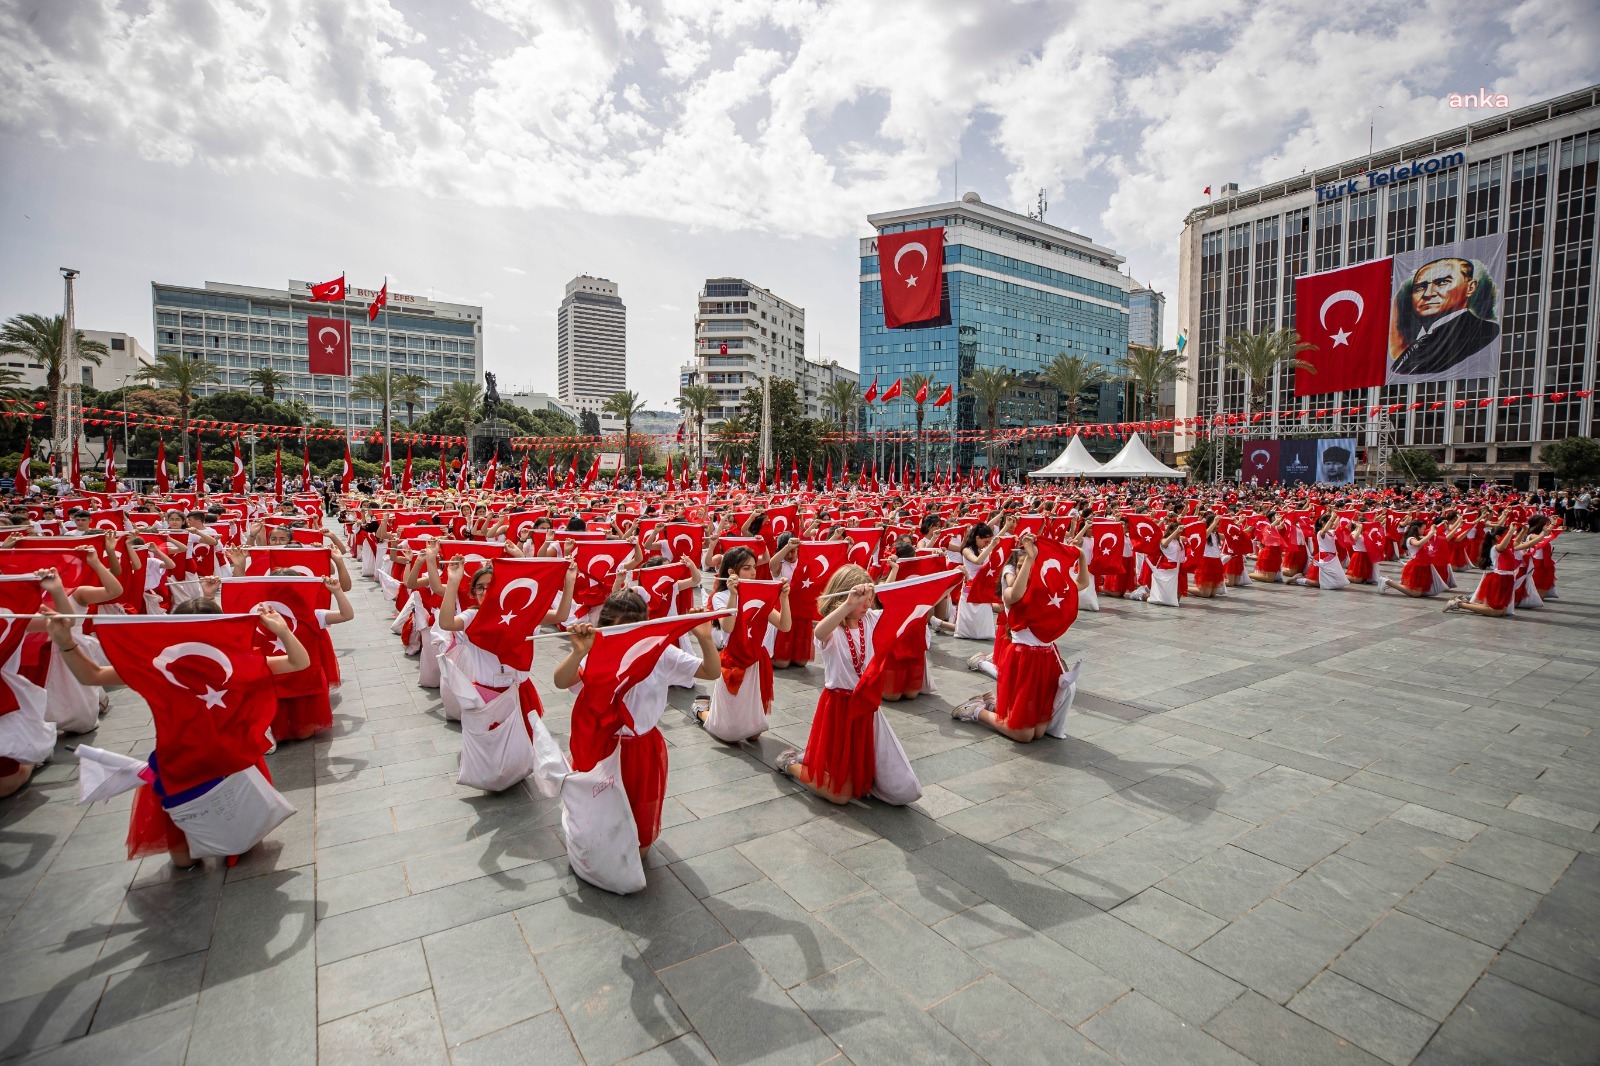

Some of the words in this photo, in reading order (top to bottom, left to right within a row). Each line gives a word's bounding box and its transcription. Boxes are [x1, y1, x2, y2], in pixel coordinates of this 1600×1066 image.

[1315, 178, 1358, 202] Türk
[1366, 151, 1464, 188] Telekom
[393, 293, 415, 302] EFES
